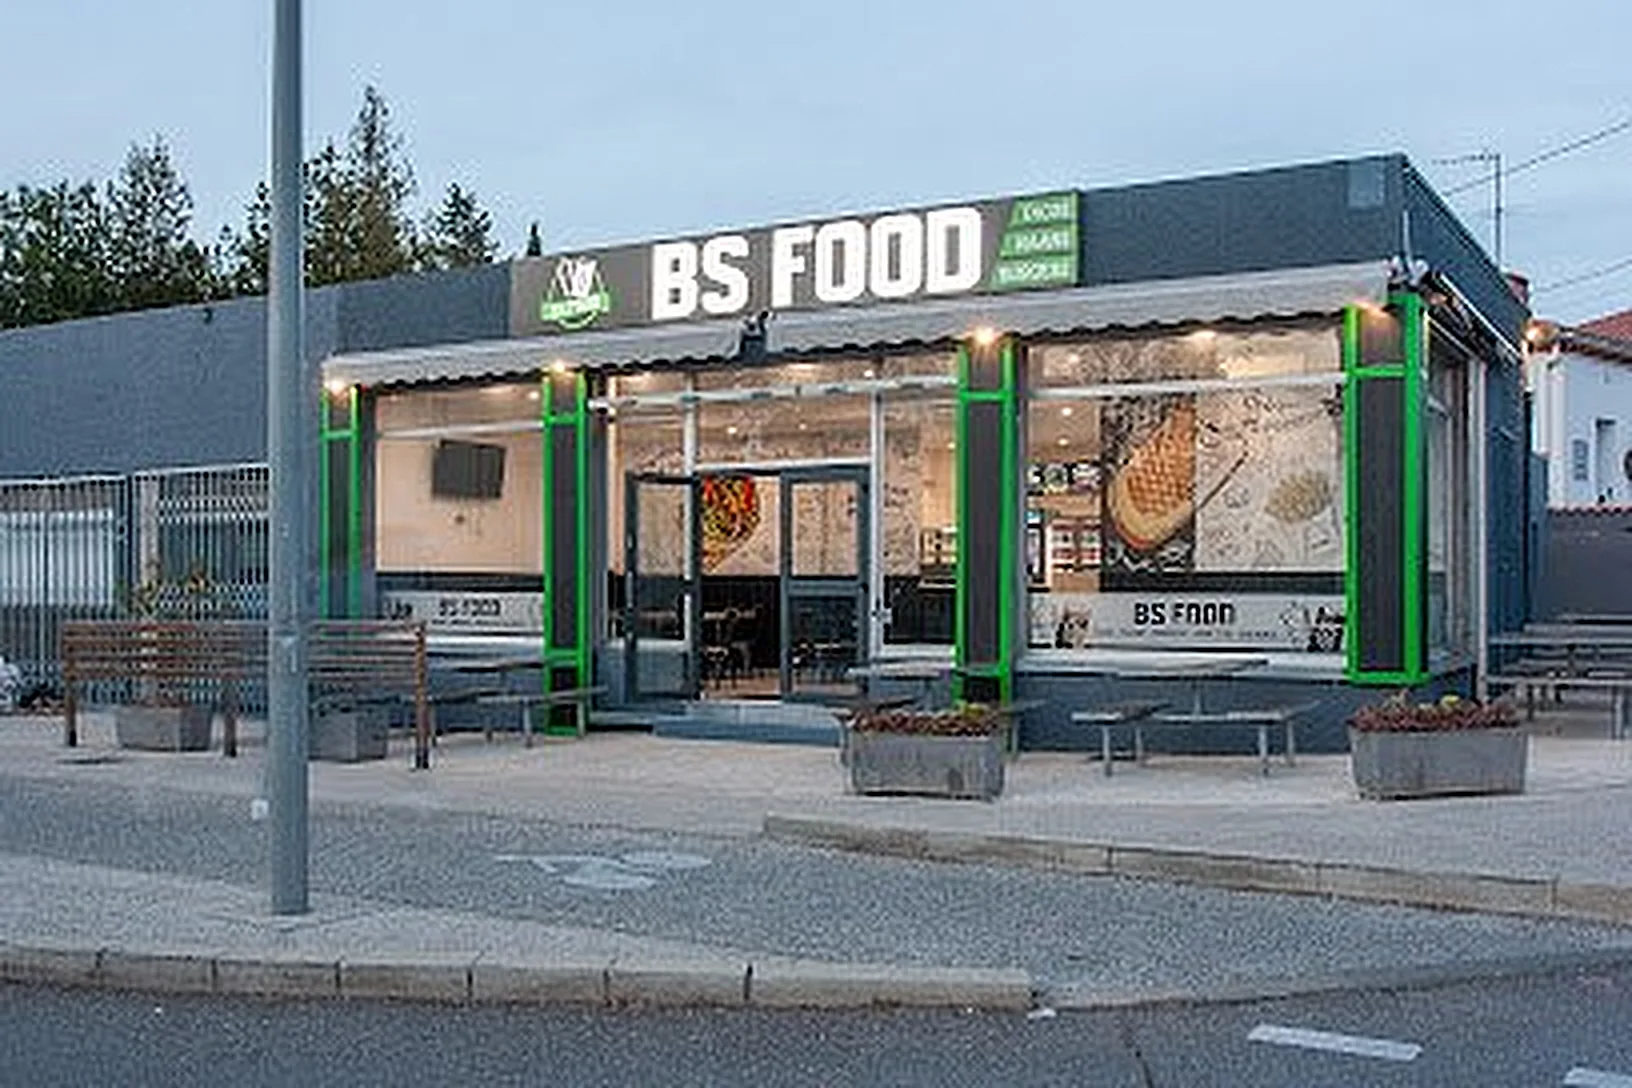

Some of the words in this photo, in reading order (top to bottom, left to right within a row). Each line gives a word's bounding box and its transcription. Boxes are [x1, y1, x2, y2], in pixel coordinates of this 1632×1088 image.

[651, 233, 749, 322] BS
[771, 207, 983, 308] FOOD
[1134, 603, 1166, 625] BS
[1173, 602, 1236, 625] FOOD
